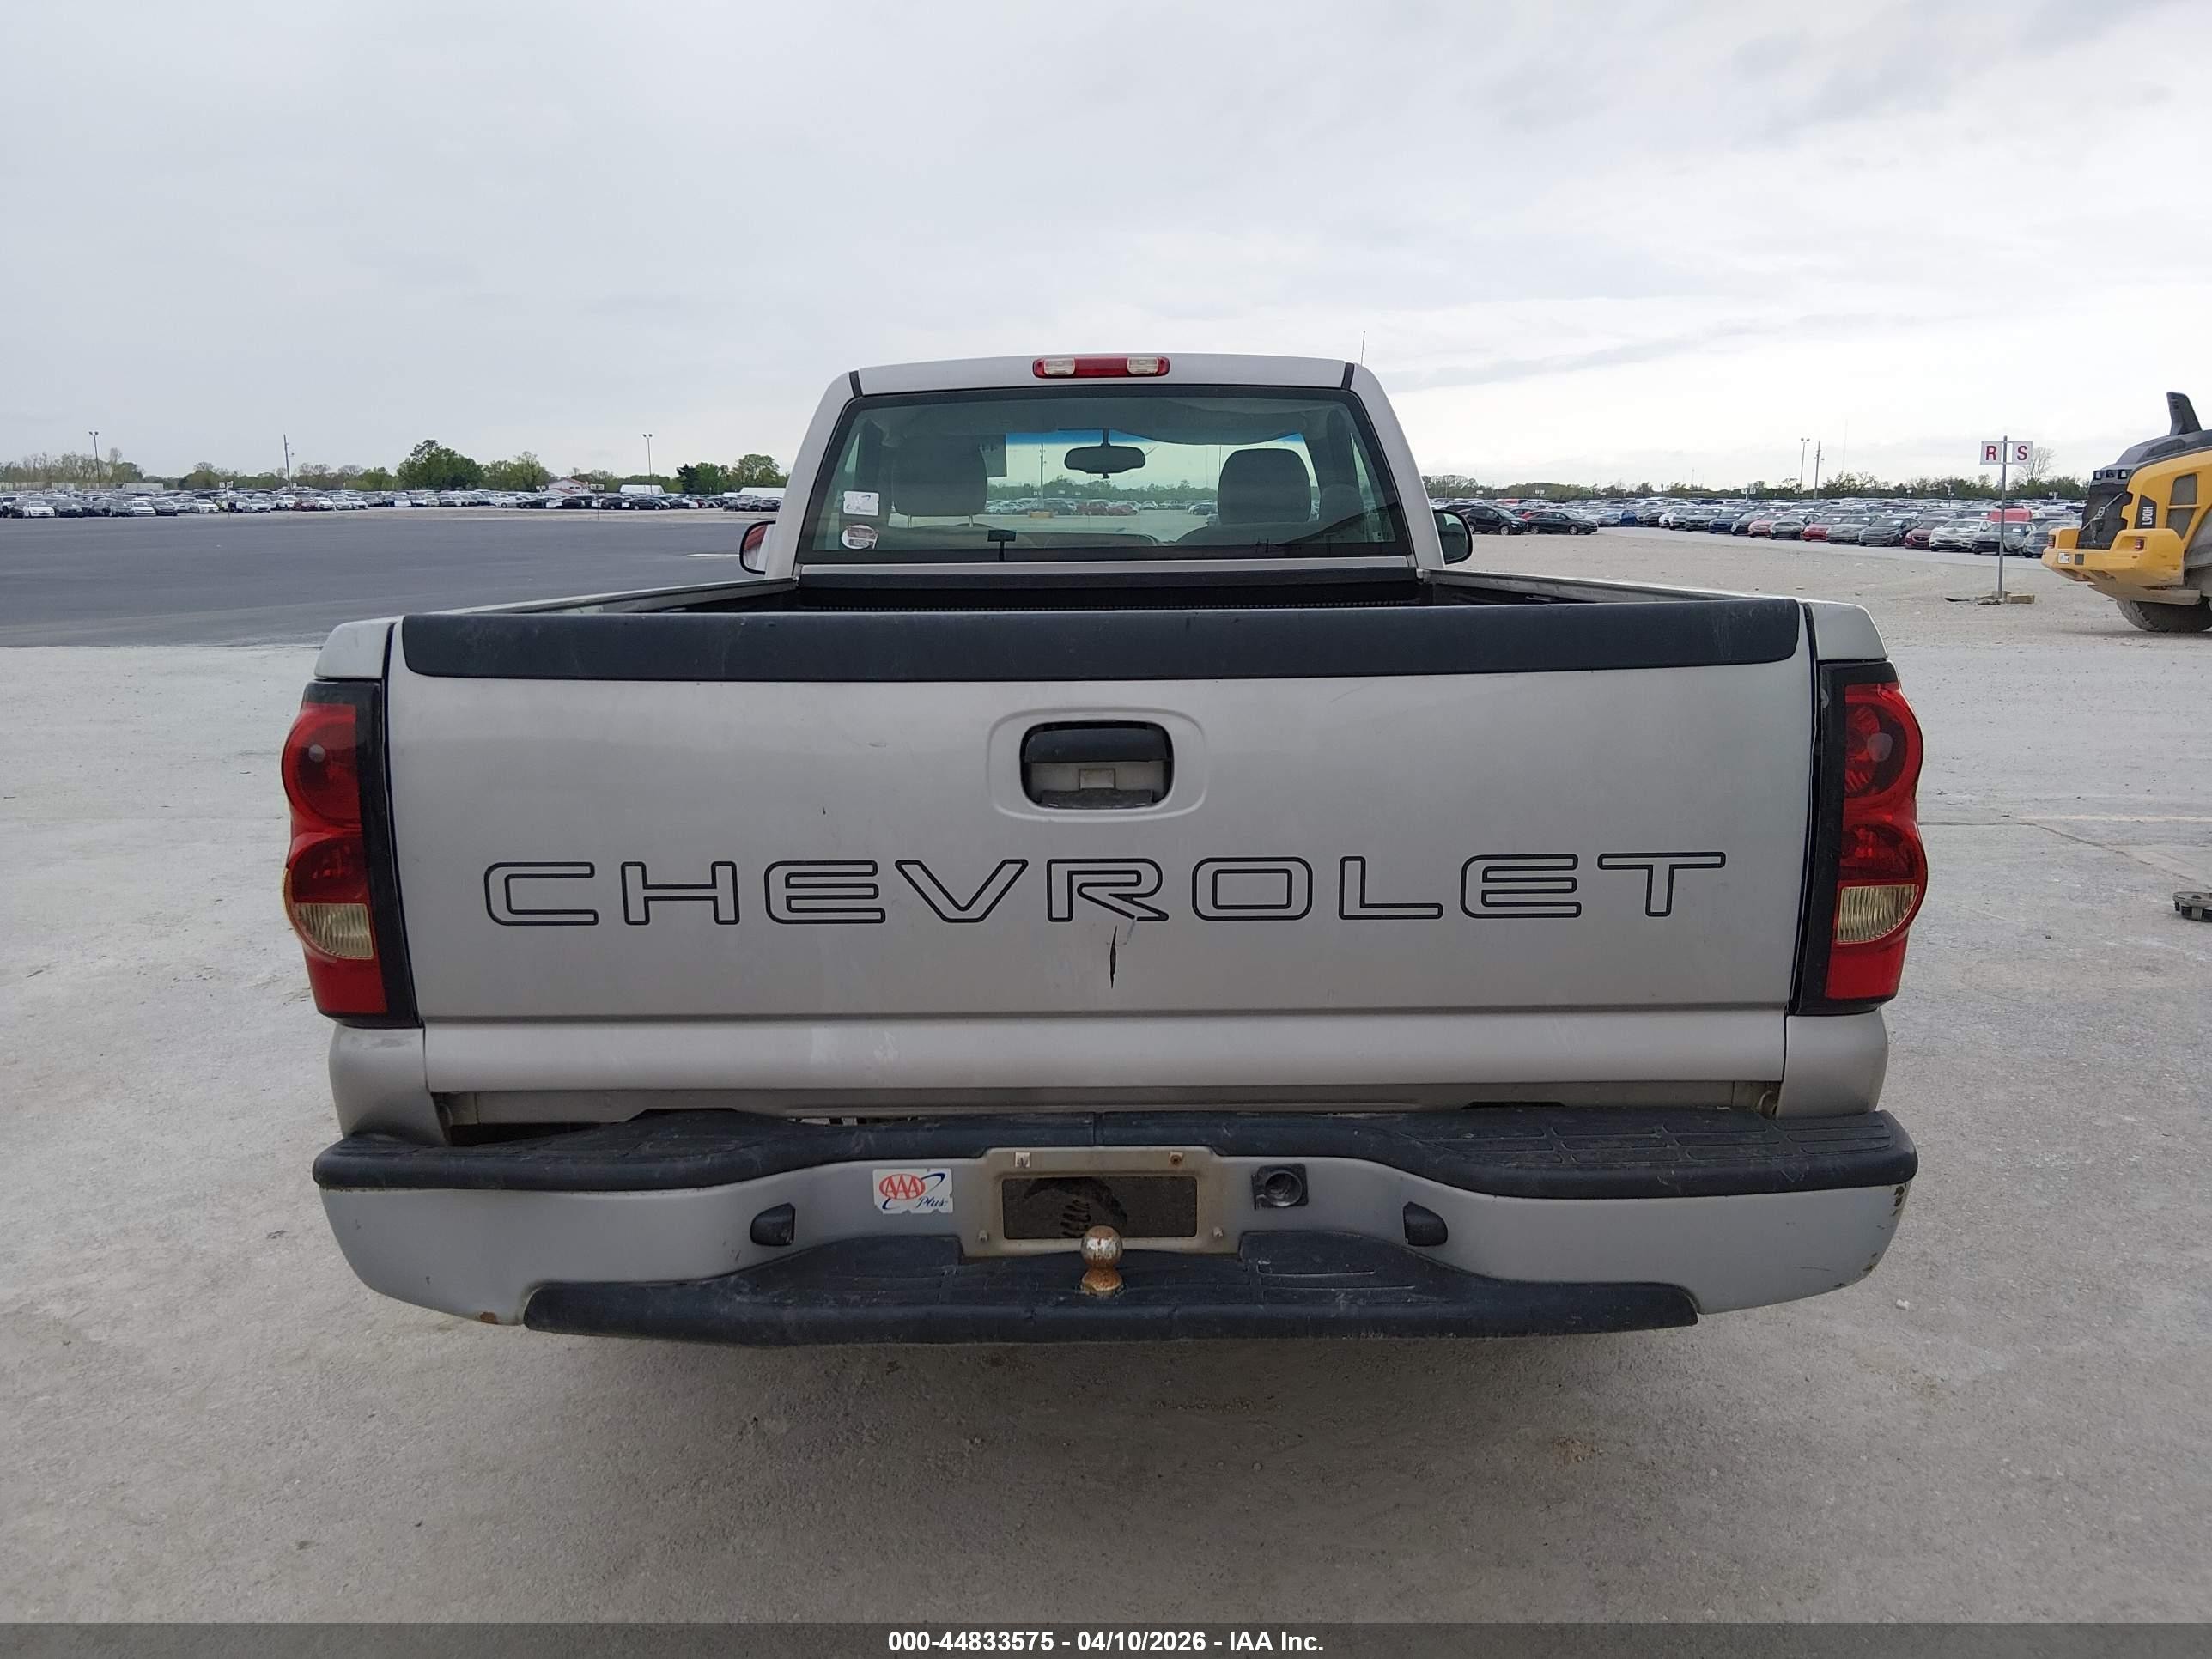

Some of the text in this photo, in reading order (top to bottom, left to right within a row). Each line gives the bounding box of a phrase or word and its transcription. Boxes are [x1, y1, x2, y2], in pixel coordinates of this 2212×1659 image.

[1985, 445, 1997, 461] R
[2016, 445, 2028, 461] S
[2142, 506, 2154, 526] L90H
[483, 851, 1727, 927] CHEVROLET
[884, 1174, 922, 1200] AAA
